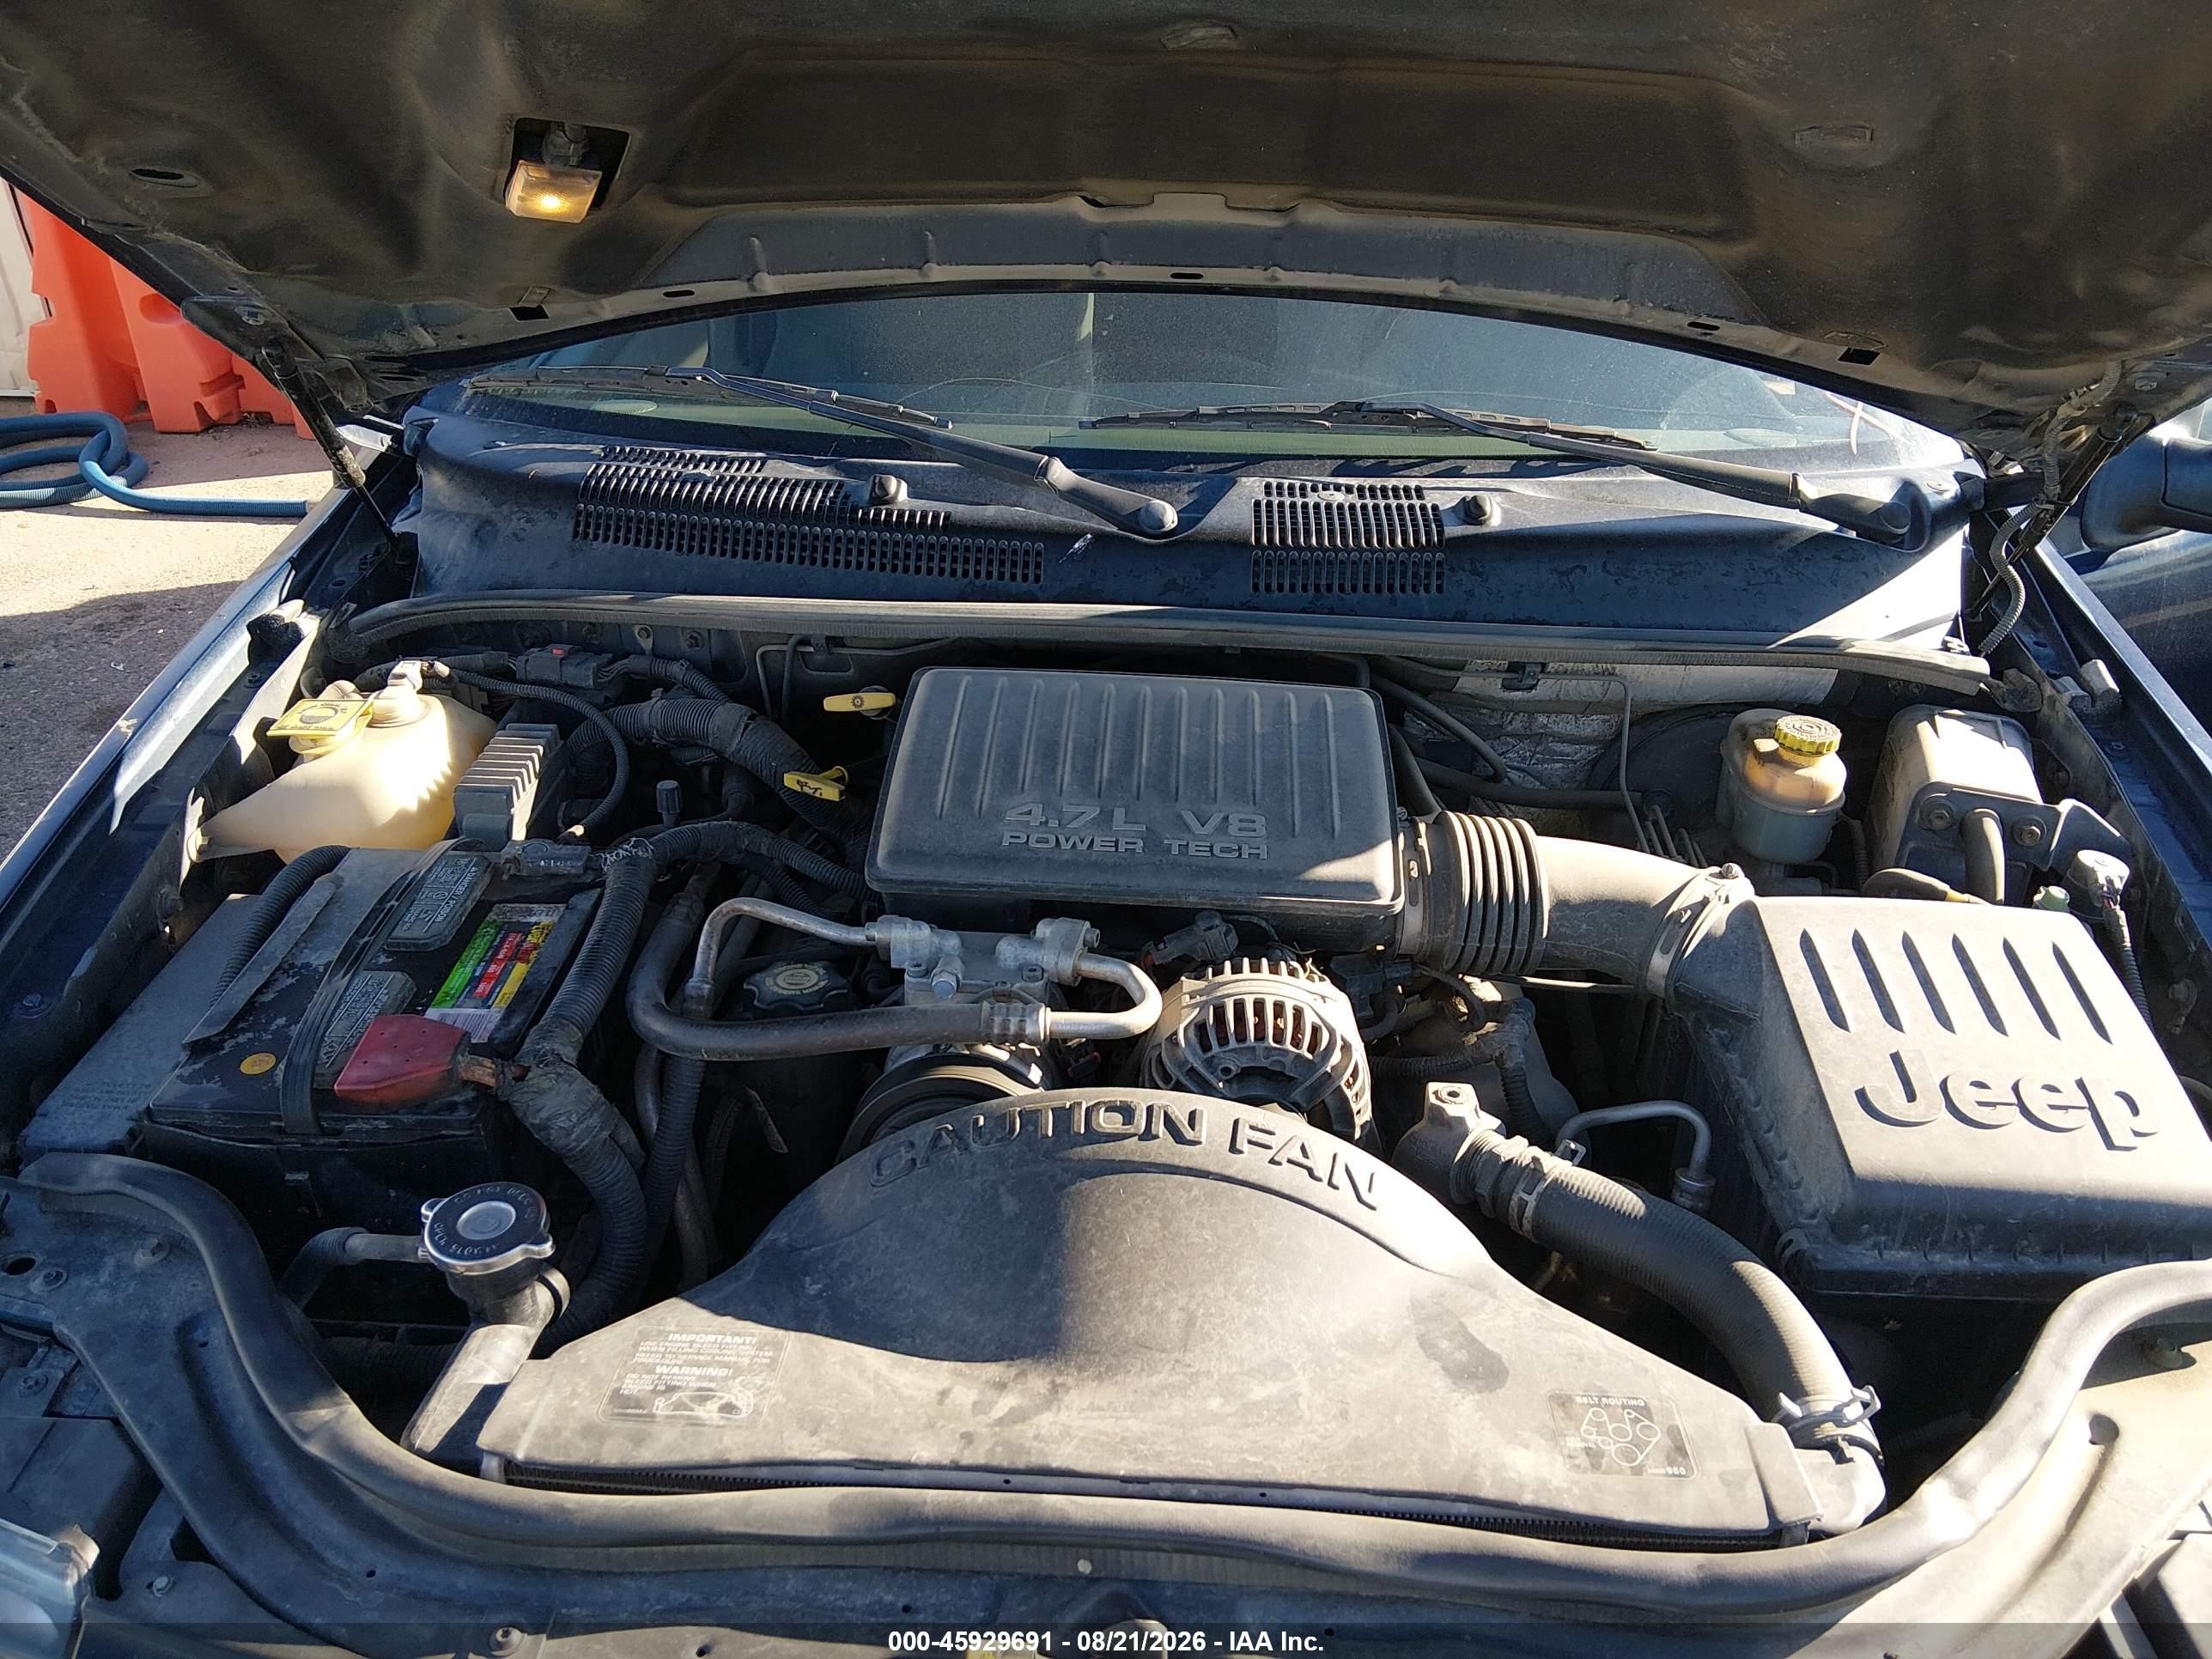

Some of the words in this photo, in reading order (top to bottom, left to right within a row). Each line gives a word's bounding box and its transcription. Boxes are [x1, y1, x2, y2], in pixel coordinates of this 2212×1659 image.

[1180, 810, 1267, 839] V8
[1001, 831, 1145, 853] POWER
[1164, 839, 1269, 860] TECH
[434, 900, 456, 922] POISON
[1853, 1049, 2159, 1152] Jeep
[869, 1098, 1209, 1188] CAUTION
[1227, 1115, 1379, 1212] FAN
[667, 1333, 757, 1346] IMPORTANT!
[654, 1364, 734, 1376] WARNING!
[1575, 1395, 1599, 1406] BELT
[1601, 1396, 1646, 1407] ROUTING
